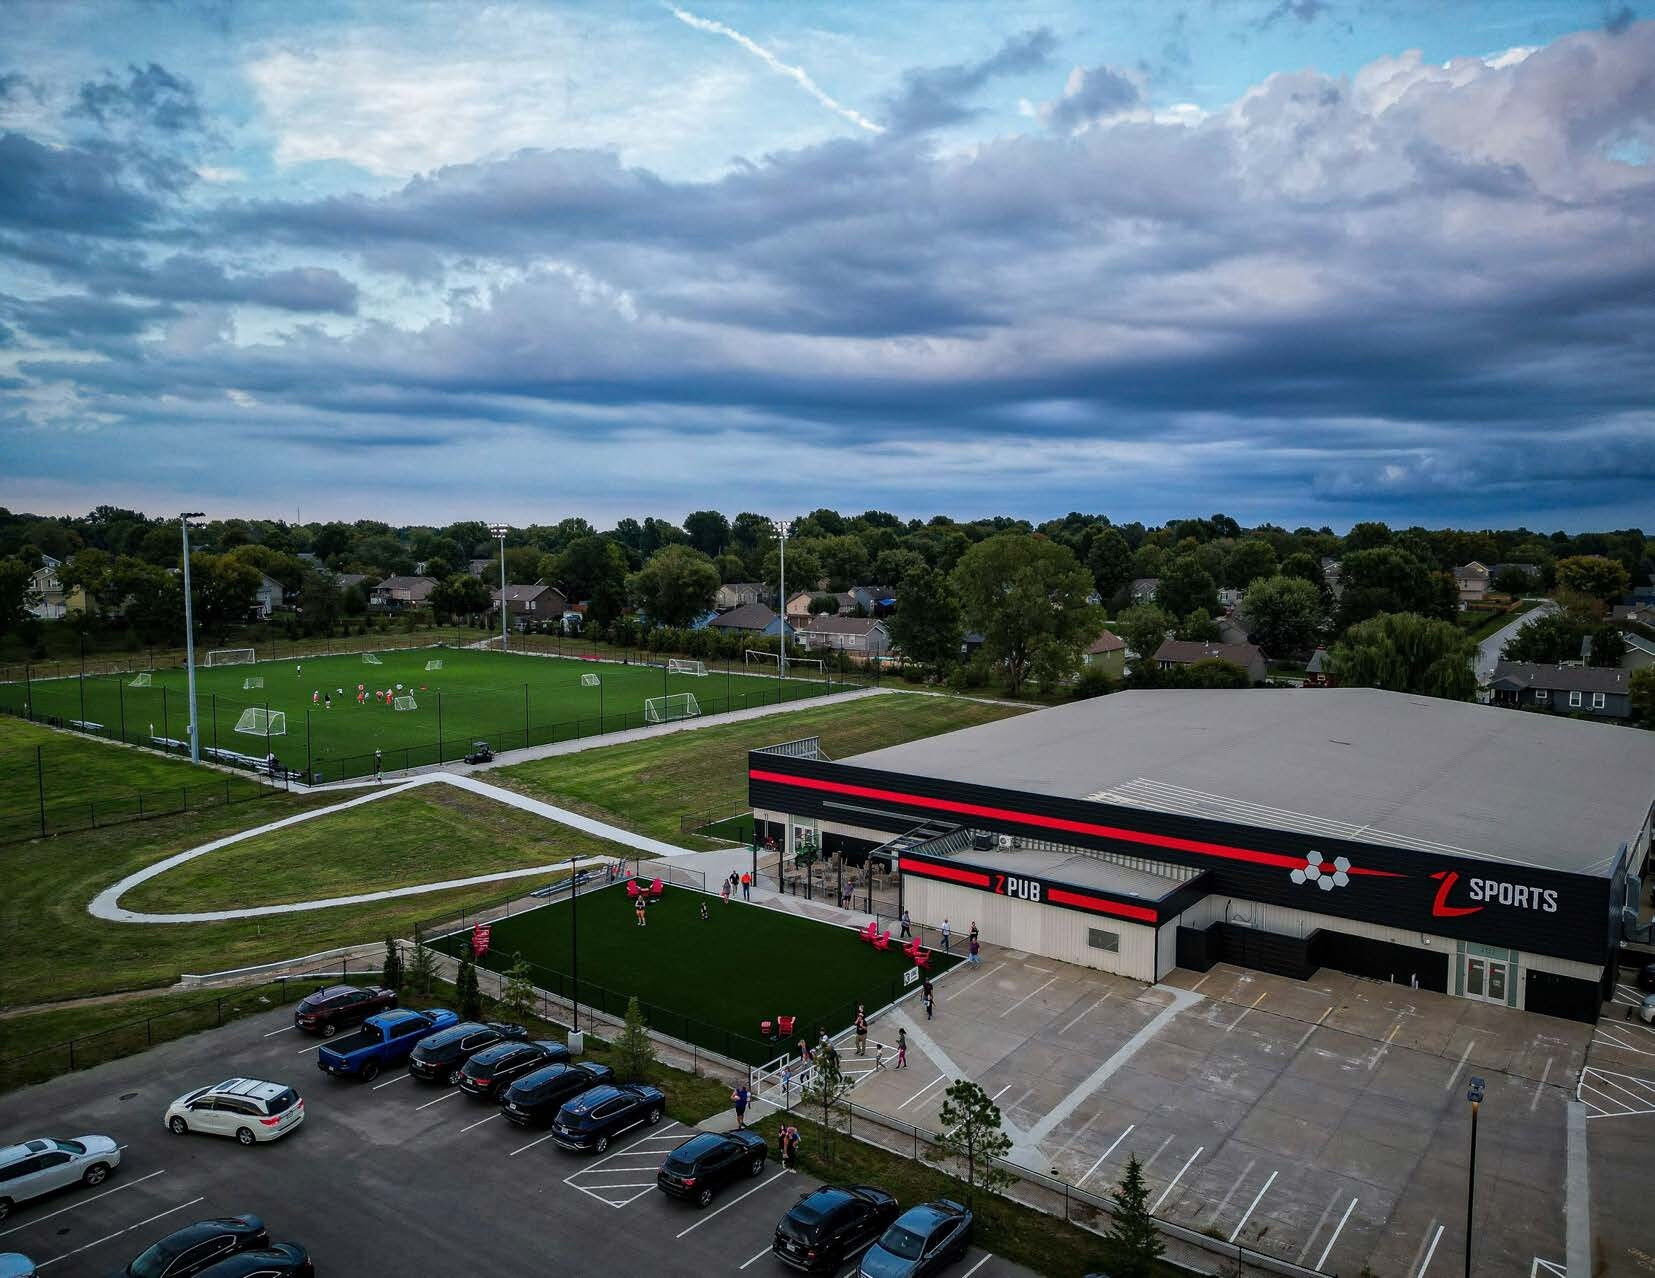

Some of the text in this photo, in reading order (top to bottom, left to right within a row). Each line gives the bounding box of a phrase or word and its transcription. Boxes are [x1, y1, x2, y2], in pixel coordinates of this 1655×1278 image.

[995, 874, 1041, 902] Z PUB
[1469, 878, 1558, 912] SPORTS
